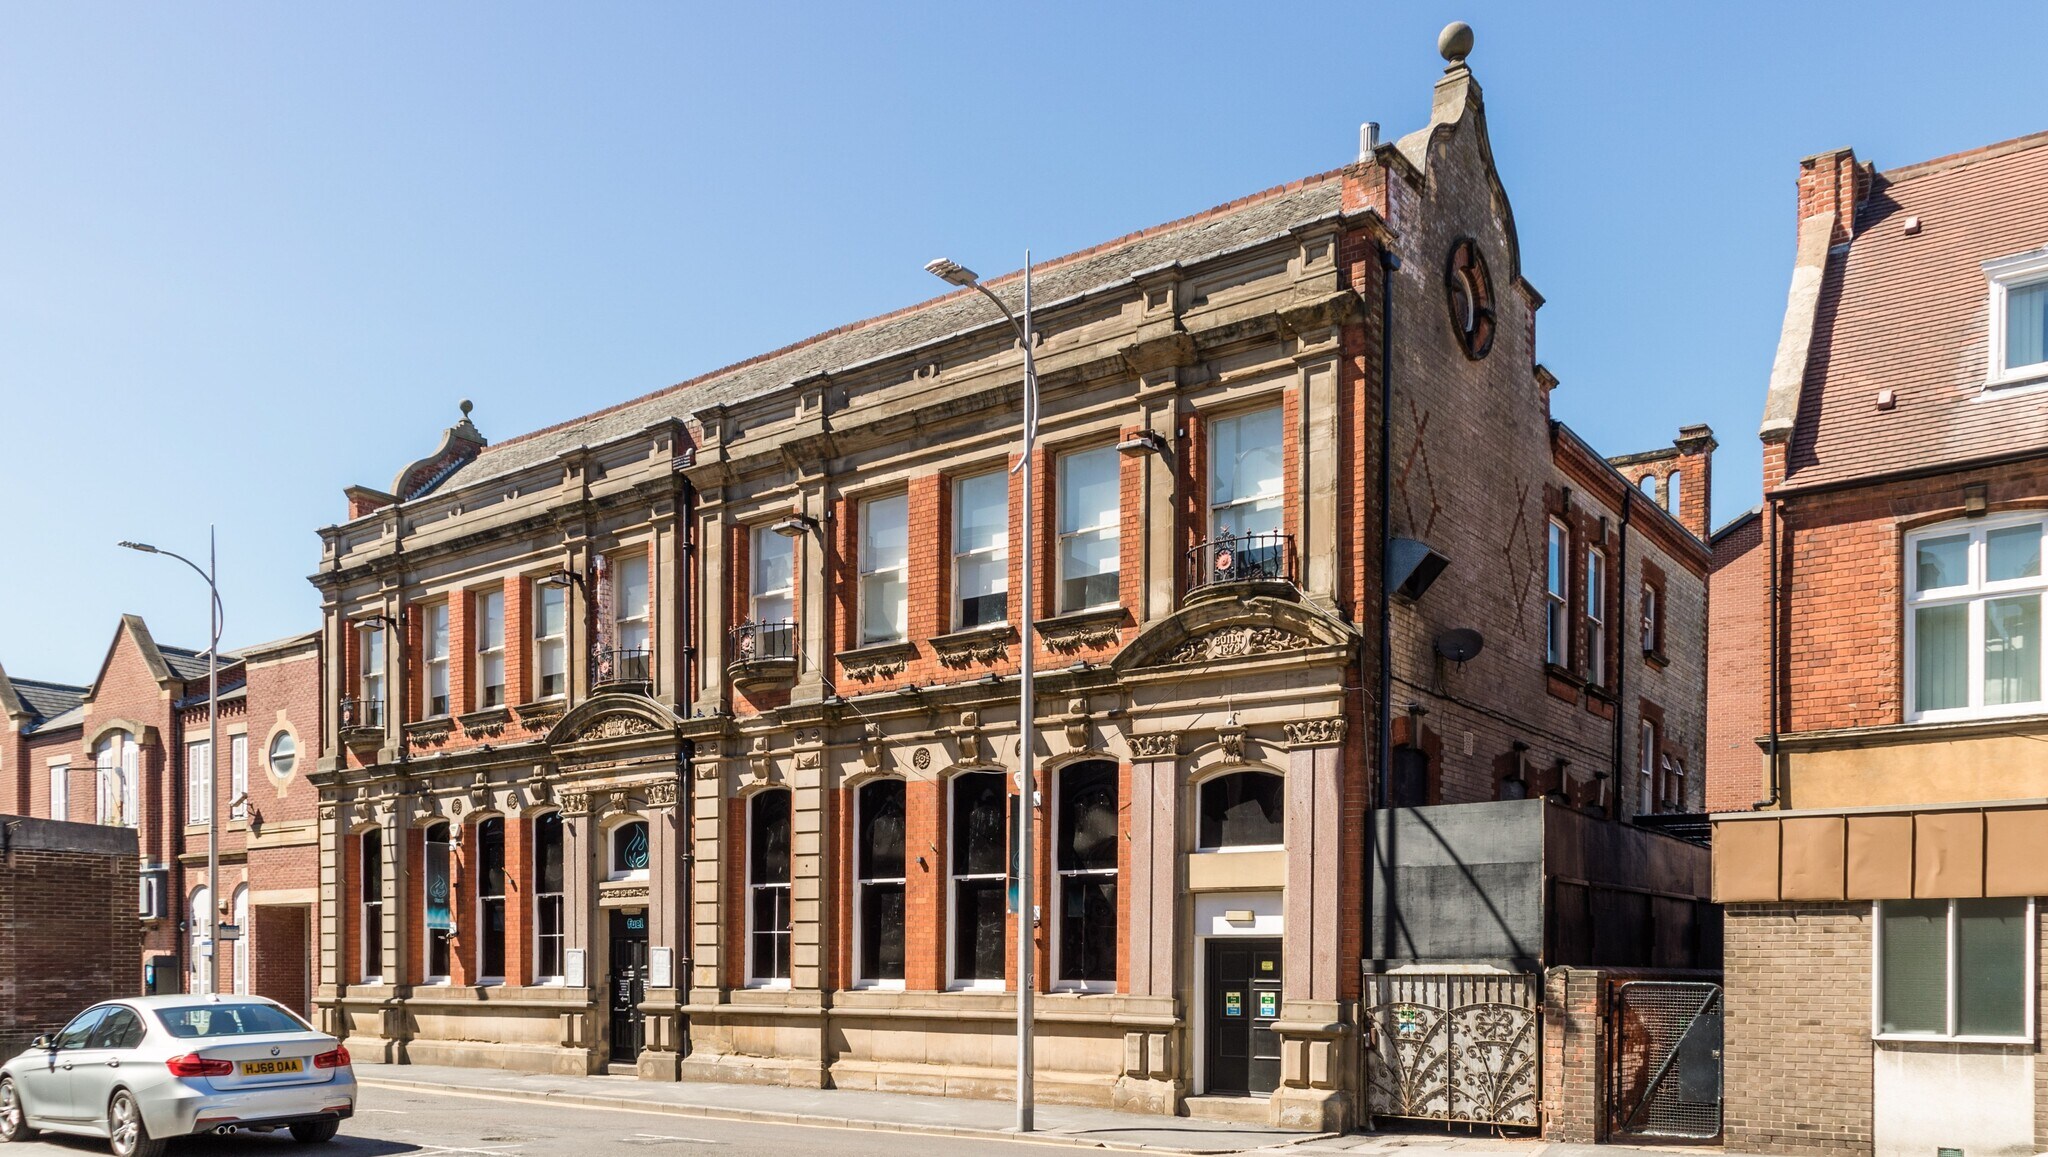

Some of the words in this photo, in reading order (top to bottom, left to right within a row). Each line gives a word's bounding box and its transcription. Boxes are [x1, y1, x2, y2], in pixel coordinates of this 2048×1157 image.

[1214, 633, 1244, 644] BUILT
[627, 918, 644, 929] fuel
[245, 1062, 274, 1073] HJ68
[277, 1060, 298, 1071] OAA
